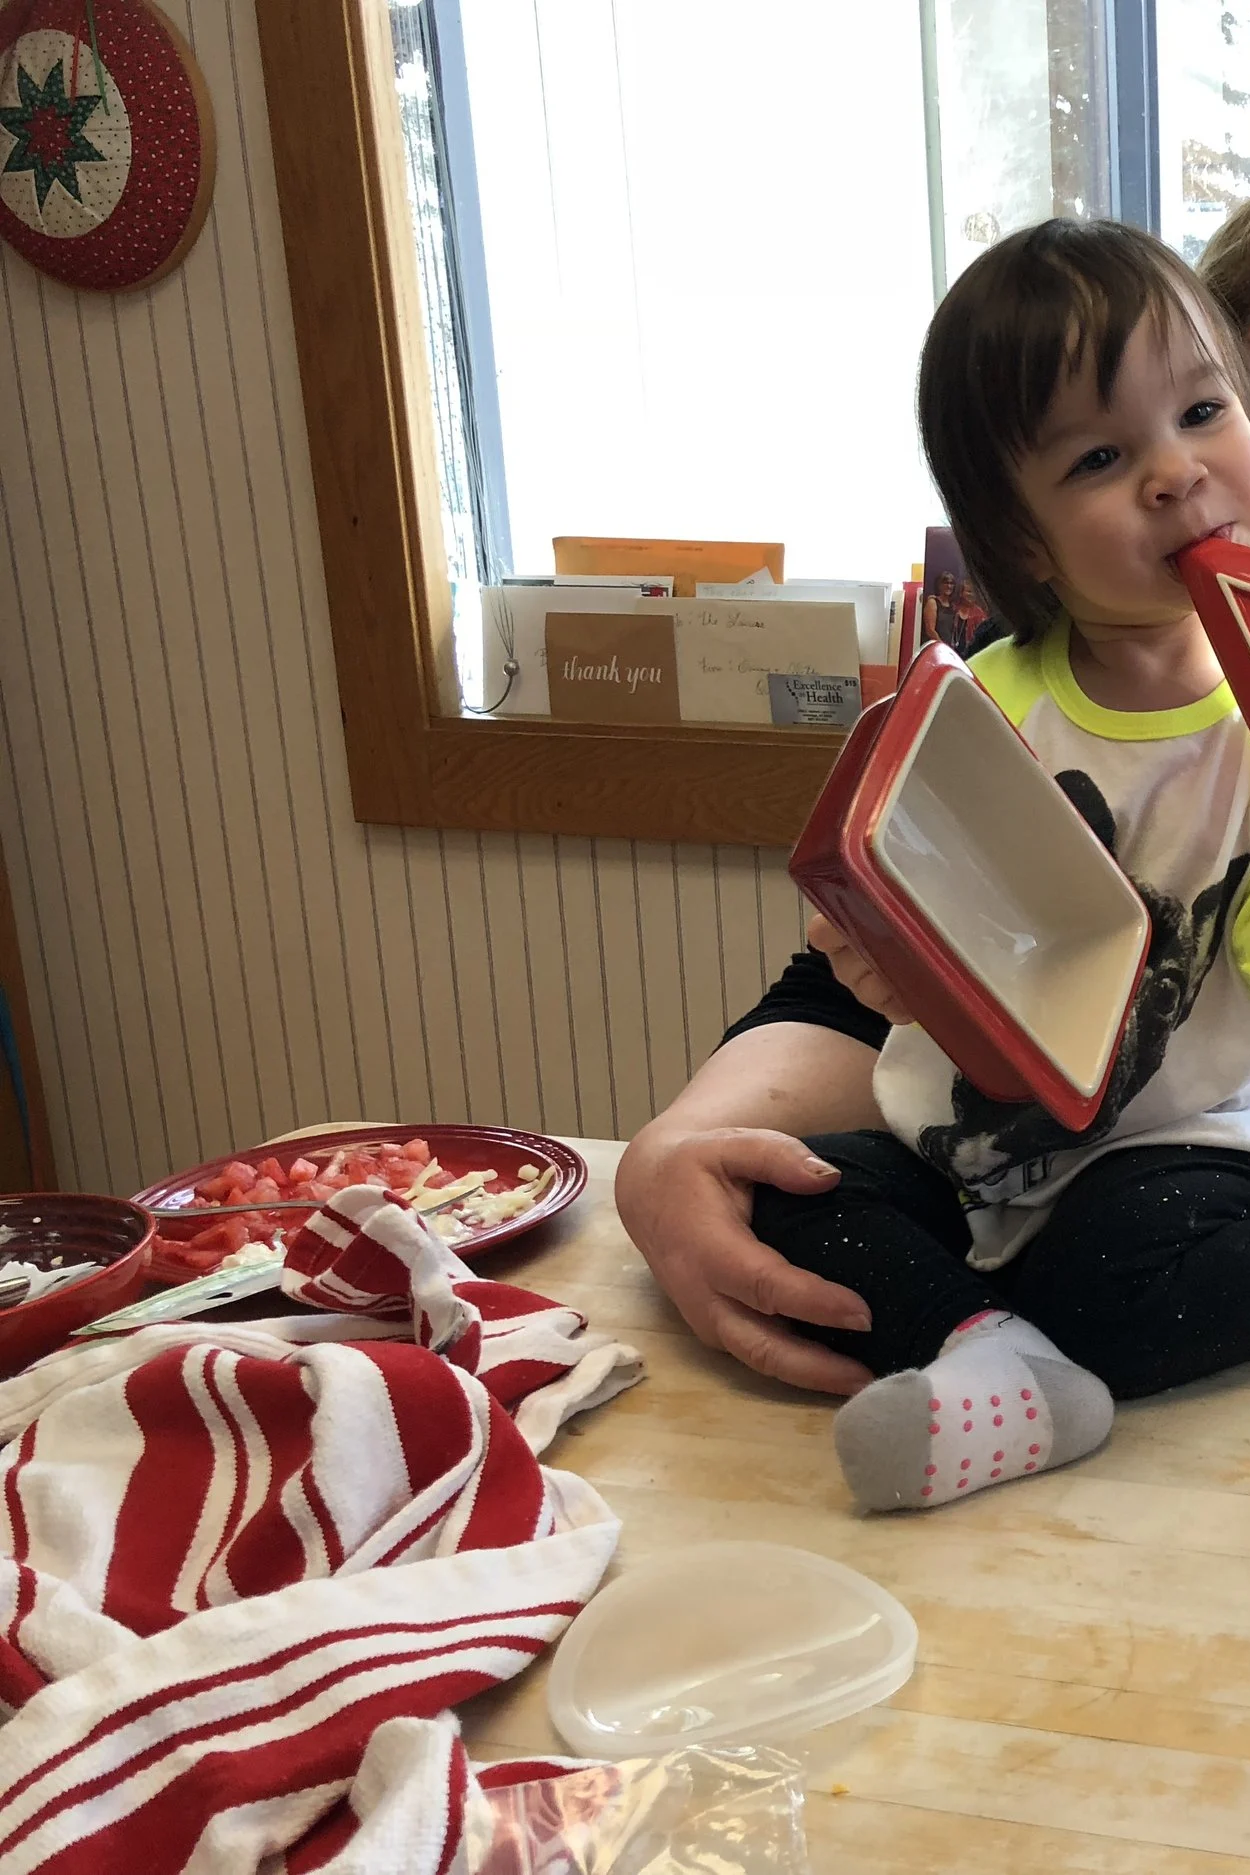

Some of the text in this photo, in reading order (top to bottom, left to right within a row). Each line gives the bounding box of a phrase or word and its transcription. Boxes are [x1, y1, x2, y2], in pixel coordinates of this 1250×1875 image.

[561, 655, 621, 683] thank
[625, 666, 662, 694] you
[793, 679, 857, 692] Excellence $15
[806, 690, 844, 704] Health
